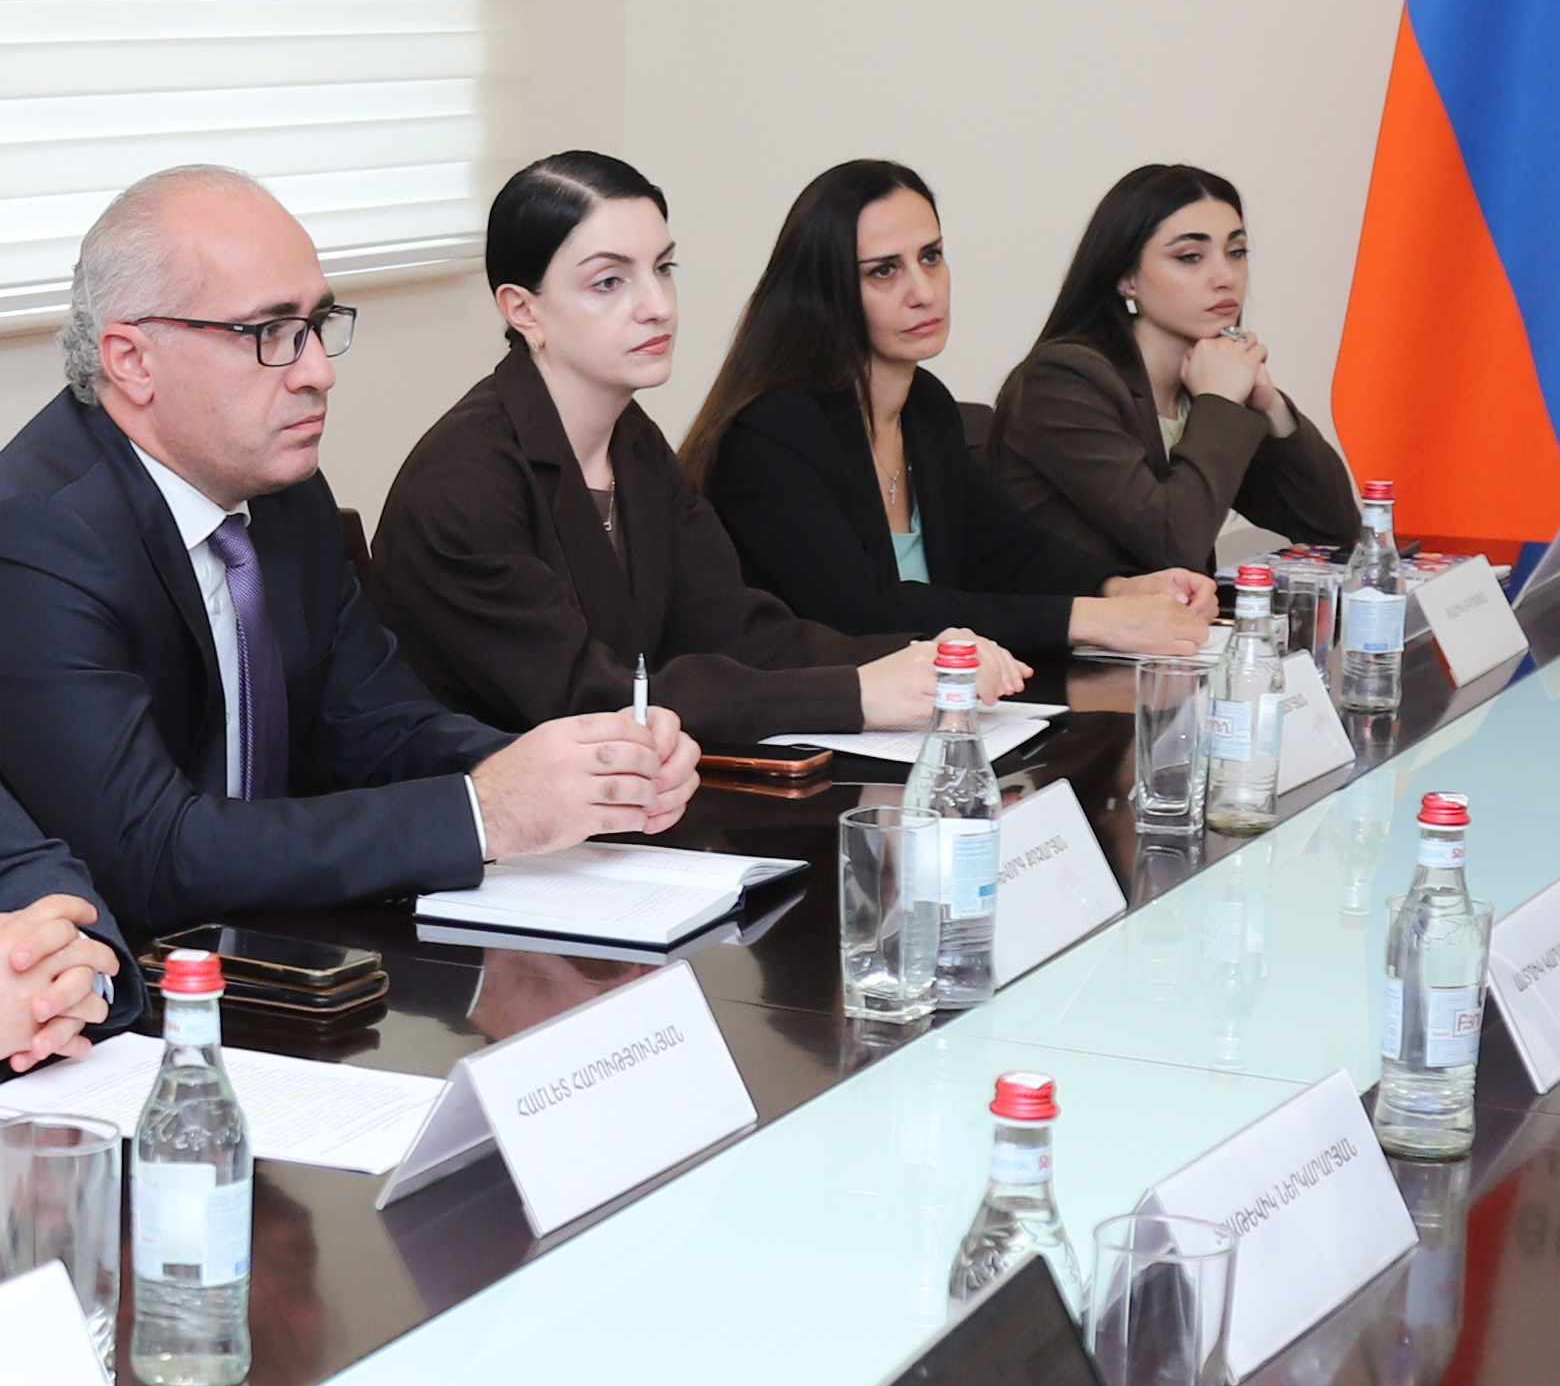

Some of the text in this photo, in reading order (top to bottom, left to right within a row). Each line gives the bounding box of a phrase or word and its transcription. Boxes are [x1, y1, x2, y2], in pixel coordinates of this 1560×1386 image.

[517, 1025, 685, 1117] ՀԱՄԼԵՏ ՀԱՐՈՒԹՅՈՒՆՅԱՆ
[1273, 1137, 1358, 1205] ՆԵՐԿԱՐԱՐՅԱՆ
